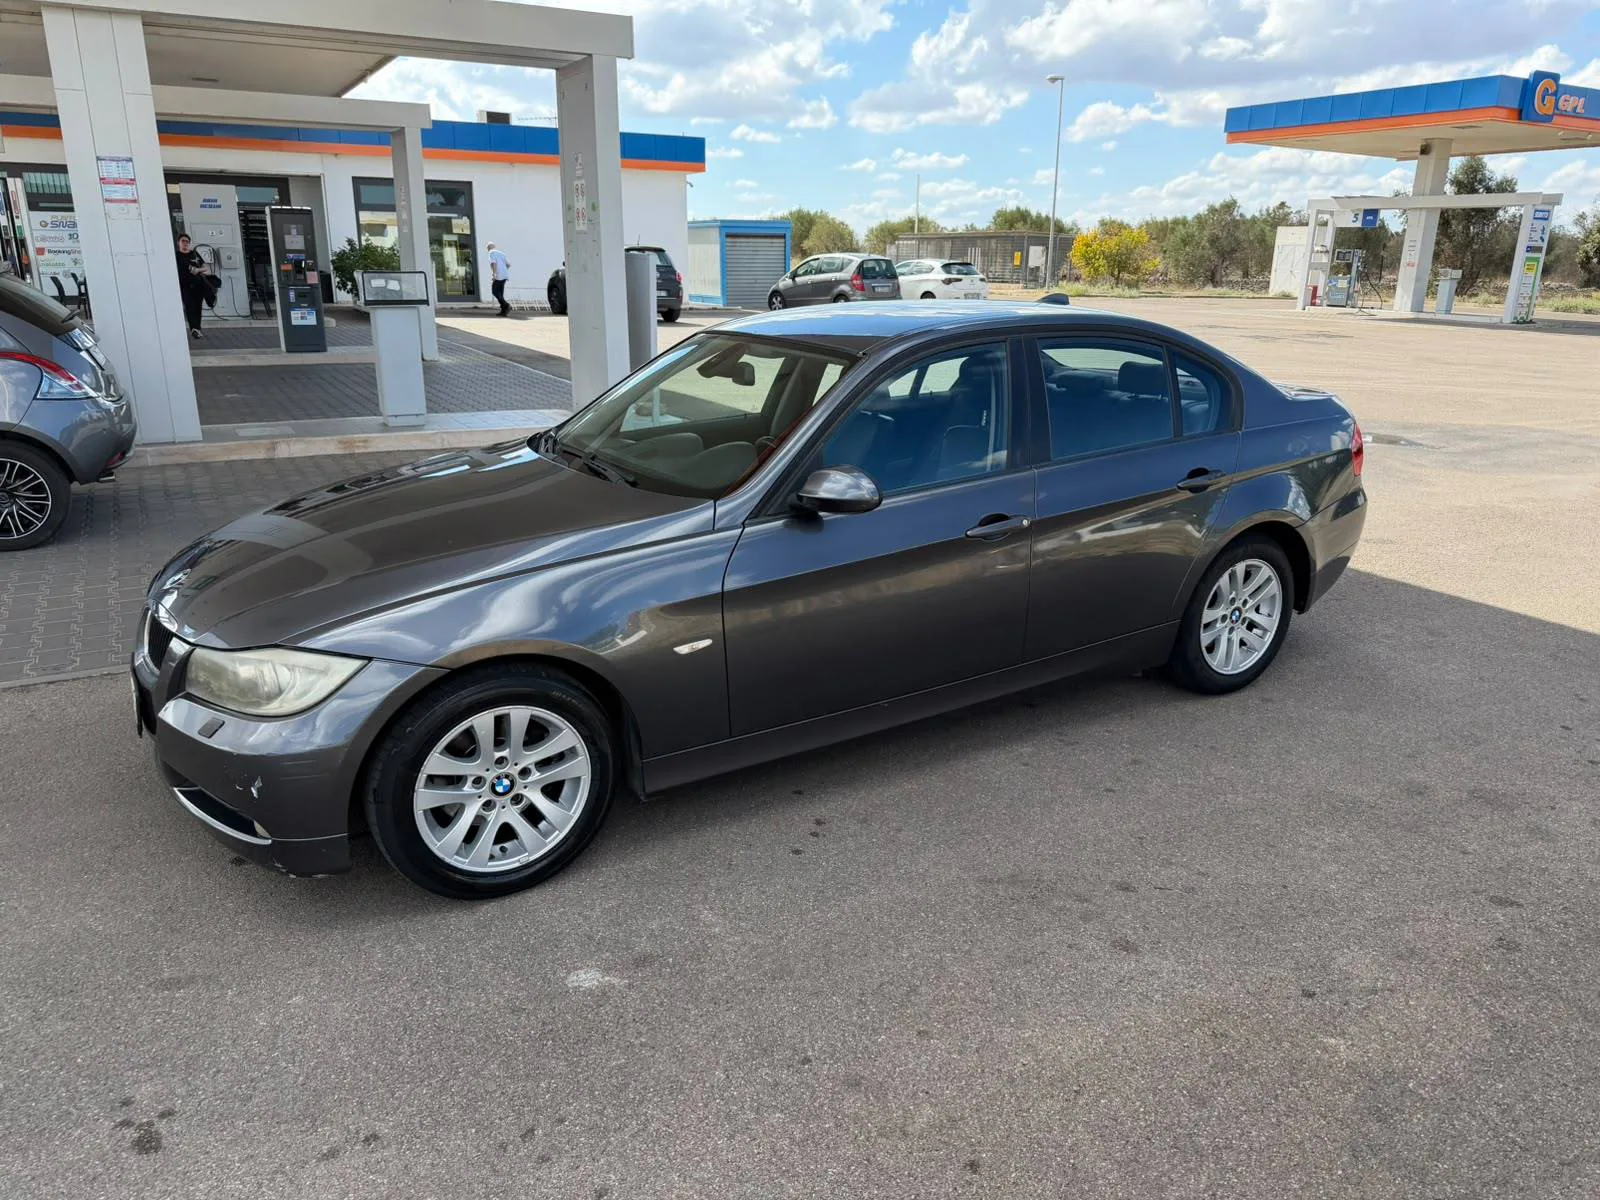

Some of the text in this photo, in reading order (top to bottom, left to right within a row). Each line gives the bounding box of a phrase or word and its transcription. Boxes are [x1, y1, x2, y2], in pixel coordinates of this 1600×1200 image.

[1535, 79, 1556, 115] G
[1558, 94, 1585, 114] GPL
[1352, 213, 1359, 223] 5
